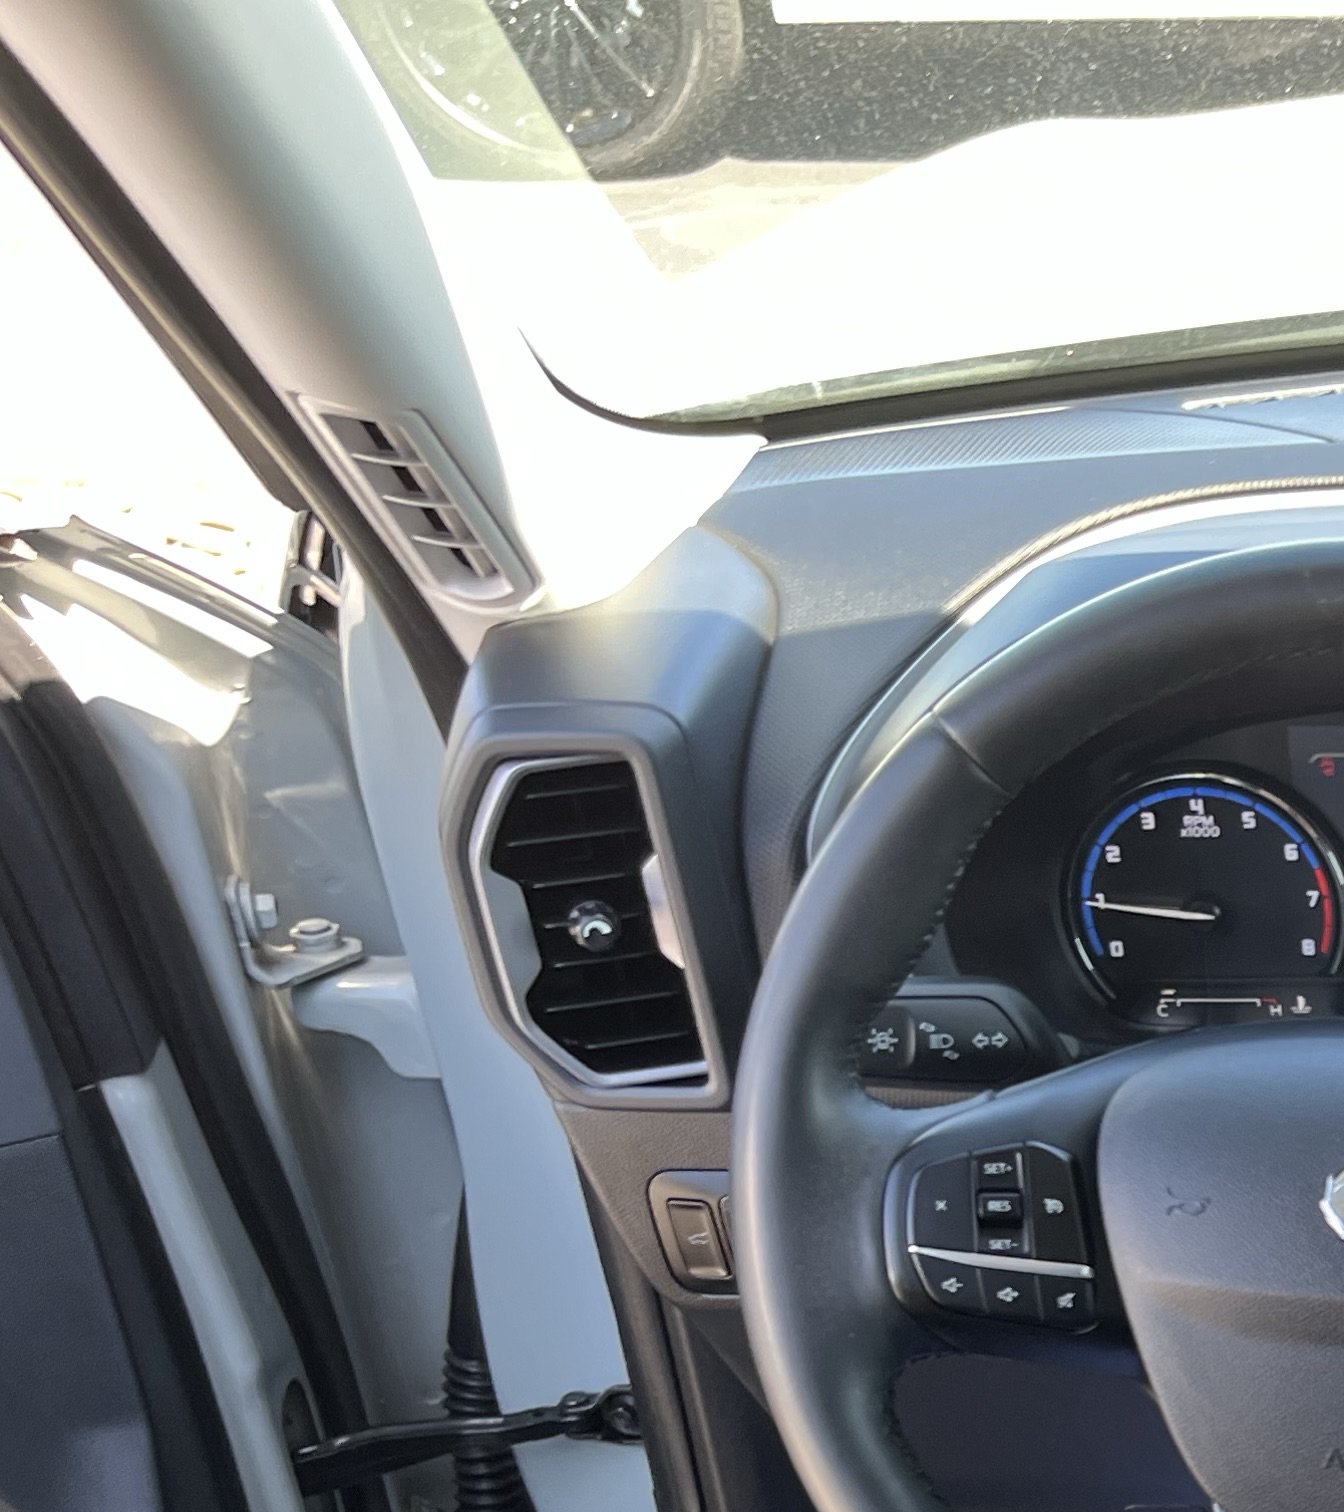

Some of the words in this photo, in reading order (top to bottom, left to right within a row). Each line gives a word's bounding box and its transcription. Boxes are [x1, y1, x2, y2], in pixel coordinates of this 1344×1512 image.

[1189, 799, 1206, 815] 4
[1140, 812, 1156, 830] 3
[1182, 815, 1215, 827] RPM
[1241, 811, 1257, 829] 5
[1105, 845, 1122, 863] 2
[1284, 844, 1299, 861] 6
[1306, 890, 1320, 908] 7
[1109, 940, 1124, 957] 0
[1301, 939, 1316, 956] 8
[1157, 1004, 1169, 1017] C
[1270, 1005, 1282, 1016] H
